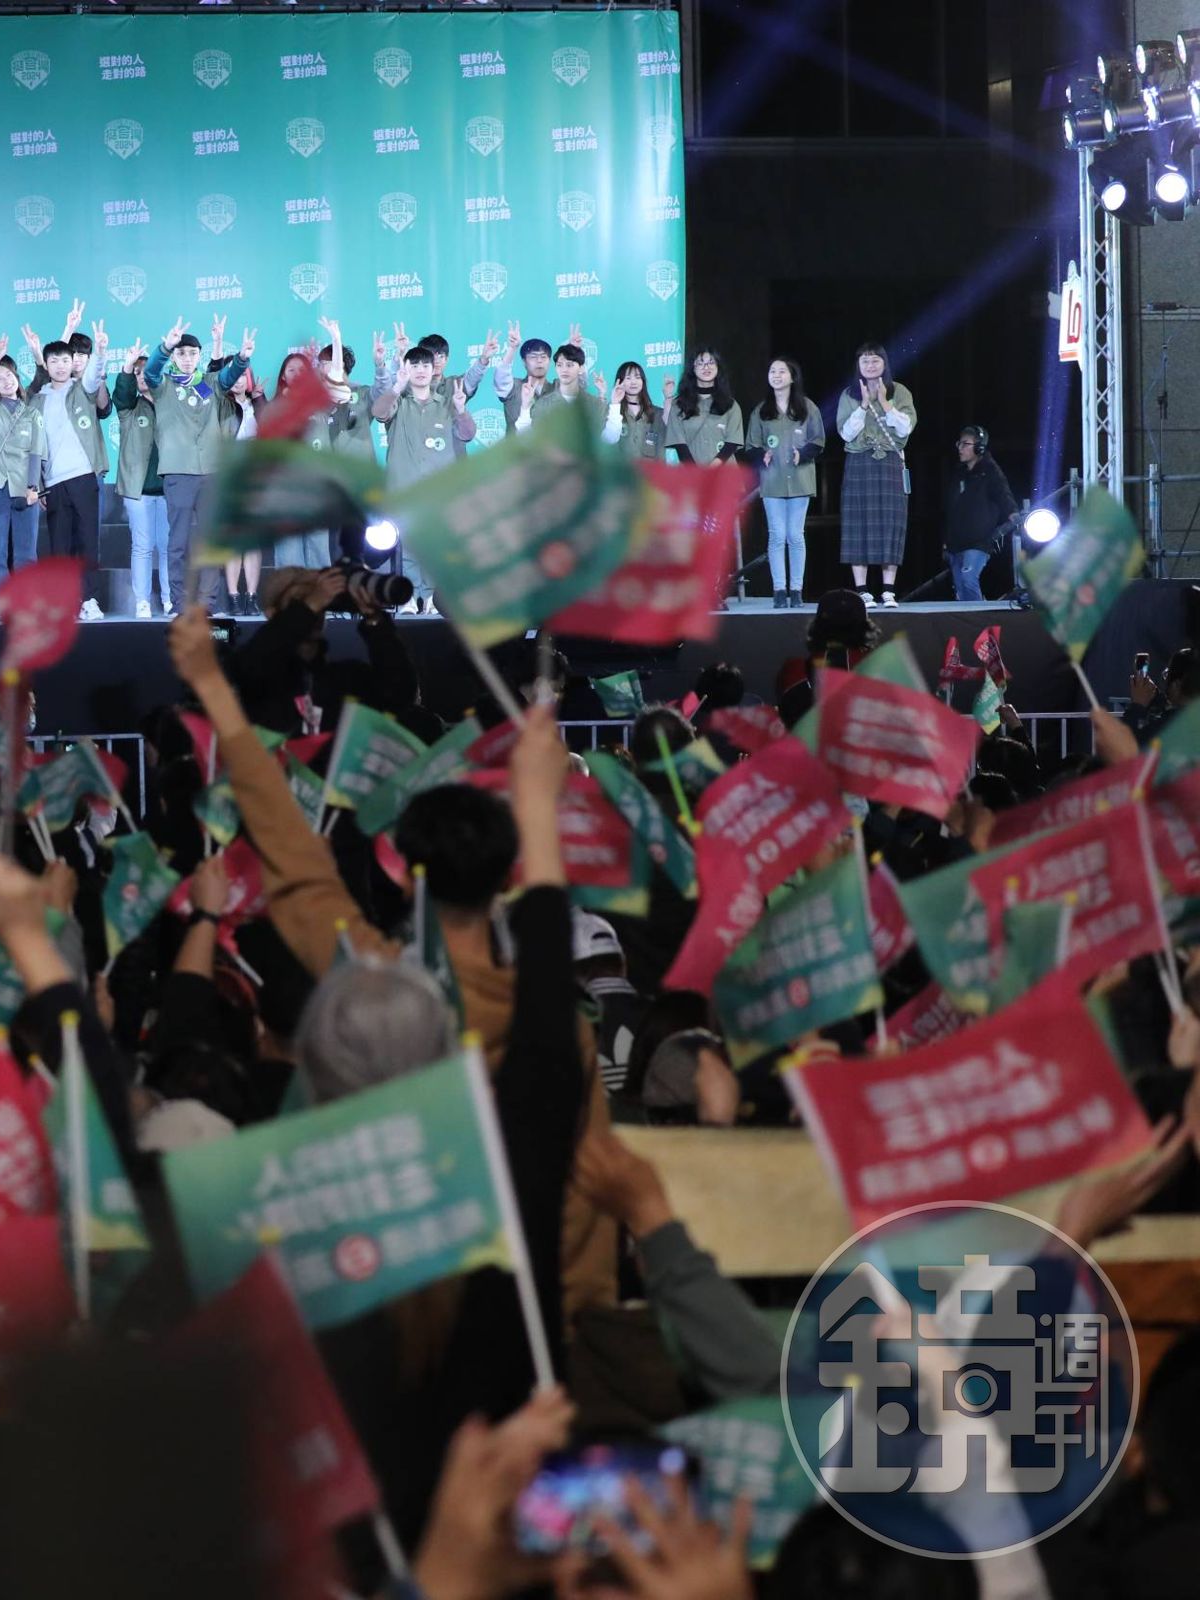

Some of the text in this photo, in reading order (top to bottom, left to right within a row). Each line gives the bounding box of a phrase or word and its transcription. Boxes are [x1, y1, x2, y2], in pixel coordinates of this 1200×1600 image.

[99, 54, 144, 68] 選對的人
[280, 52, 325, 68] 選對的人
[459, 50, 503, 65] 選對的人
[102, 65, 147, 80] 走對的路
[283, 64, 327, 80] 走對的路
[463, 63, 507, 77] 走對的路
[10, 129, 55, 144] 選對的人
[192, 127, 238, 144] 選對的人
[373, 126, 417, 141] 選對的人
[551, 126, 595, 140] 選對的人
[13, 141, 59, 156] 走對的路
[195, 140, 240, 155] 走對的路
[376, 139, 420, 154] 走對的路
[553, 138, 598, 153] 走對的路
[13, 276, 57, 292] 選對的人
[195, 274, 241, 289] 選對的人
[377, 273, 421, 287] 選對的人
[555, 272, 598, 286] 選對的人
[16, 289, 61, 303] 走對的路
[198, 287, 244, 301] 走對的路
[379, 285, 423, 300] 走對的路
[558, 284, 603, 299] 走對的路
